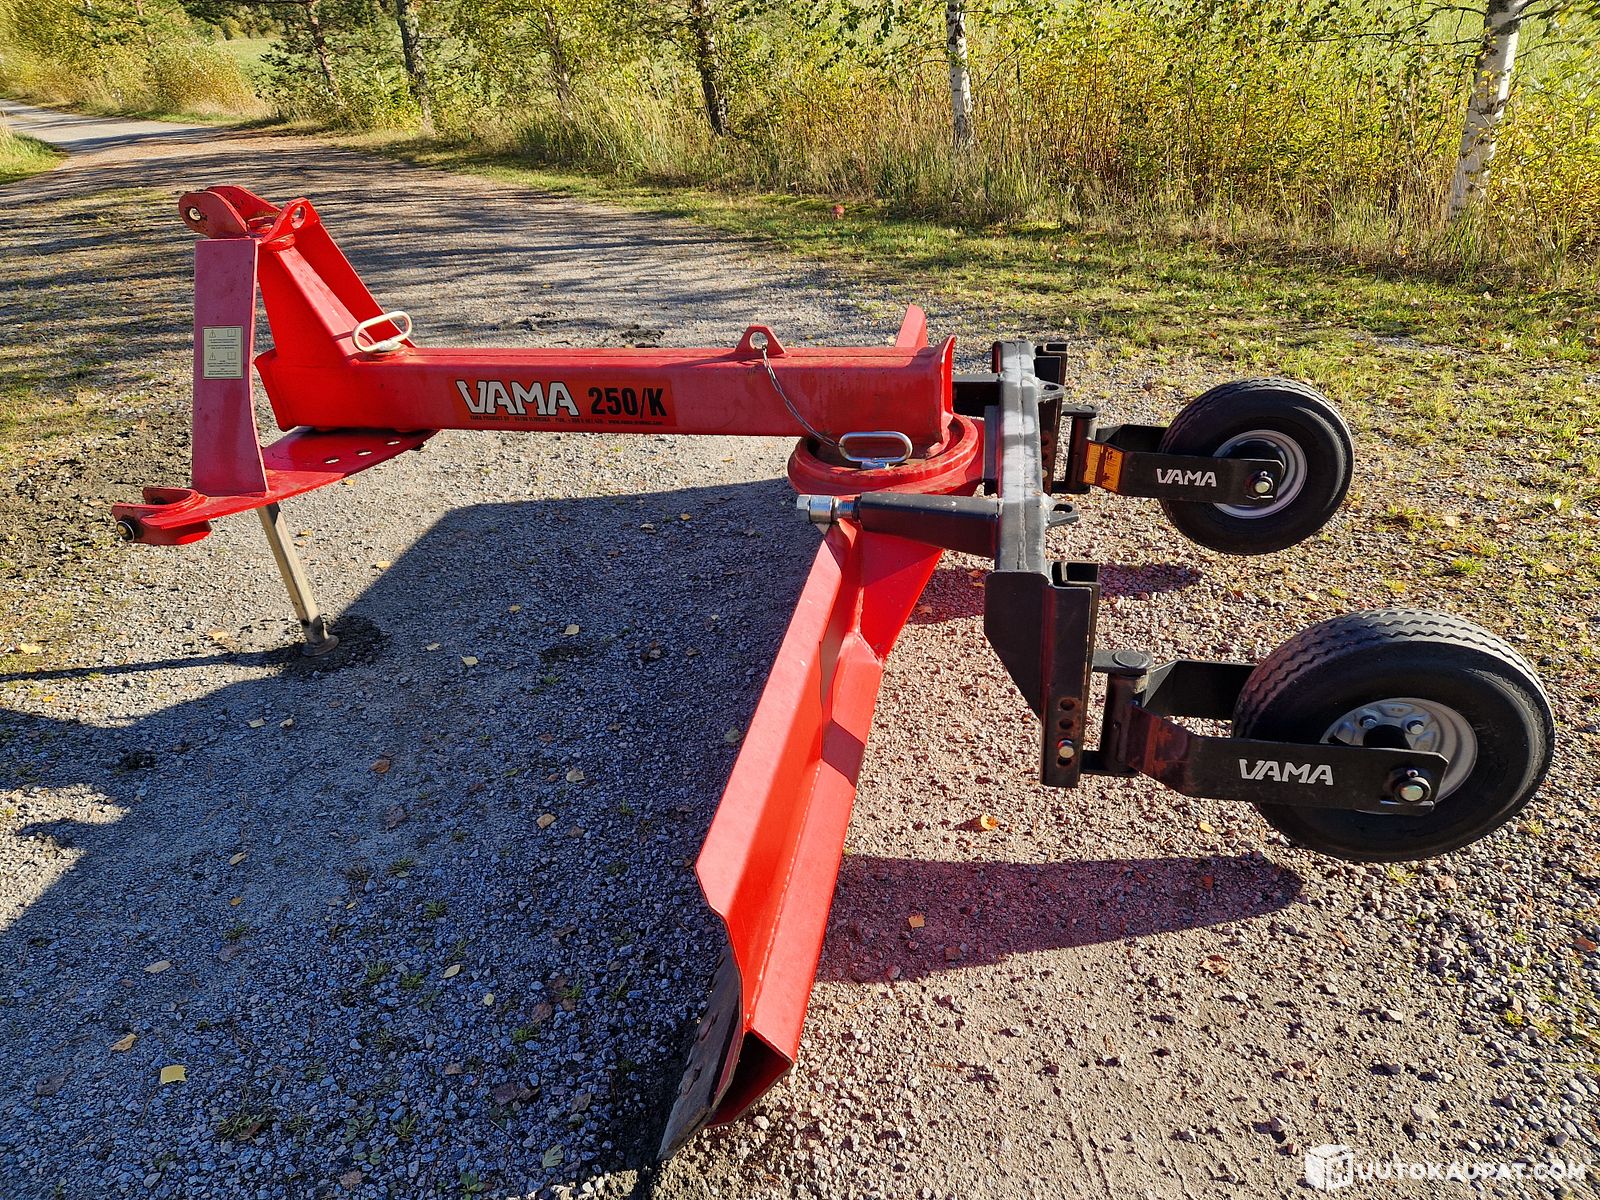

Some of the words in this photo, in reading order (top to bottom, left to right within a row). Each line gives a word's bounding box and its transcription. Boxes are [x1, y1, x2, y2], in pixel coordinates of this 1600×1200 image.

[455, 380, 580, 416] VAMA
[588, 387, 667, 419] 250/K
[1156, 468, 1217, 487] VAMA
[1239, 759, 1334, 786] VAMA
